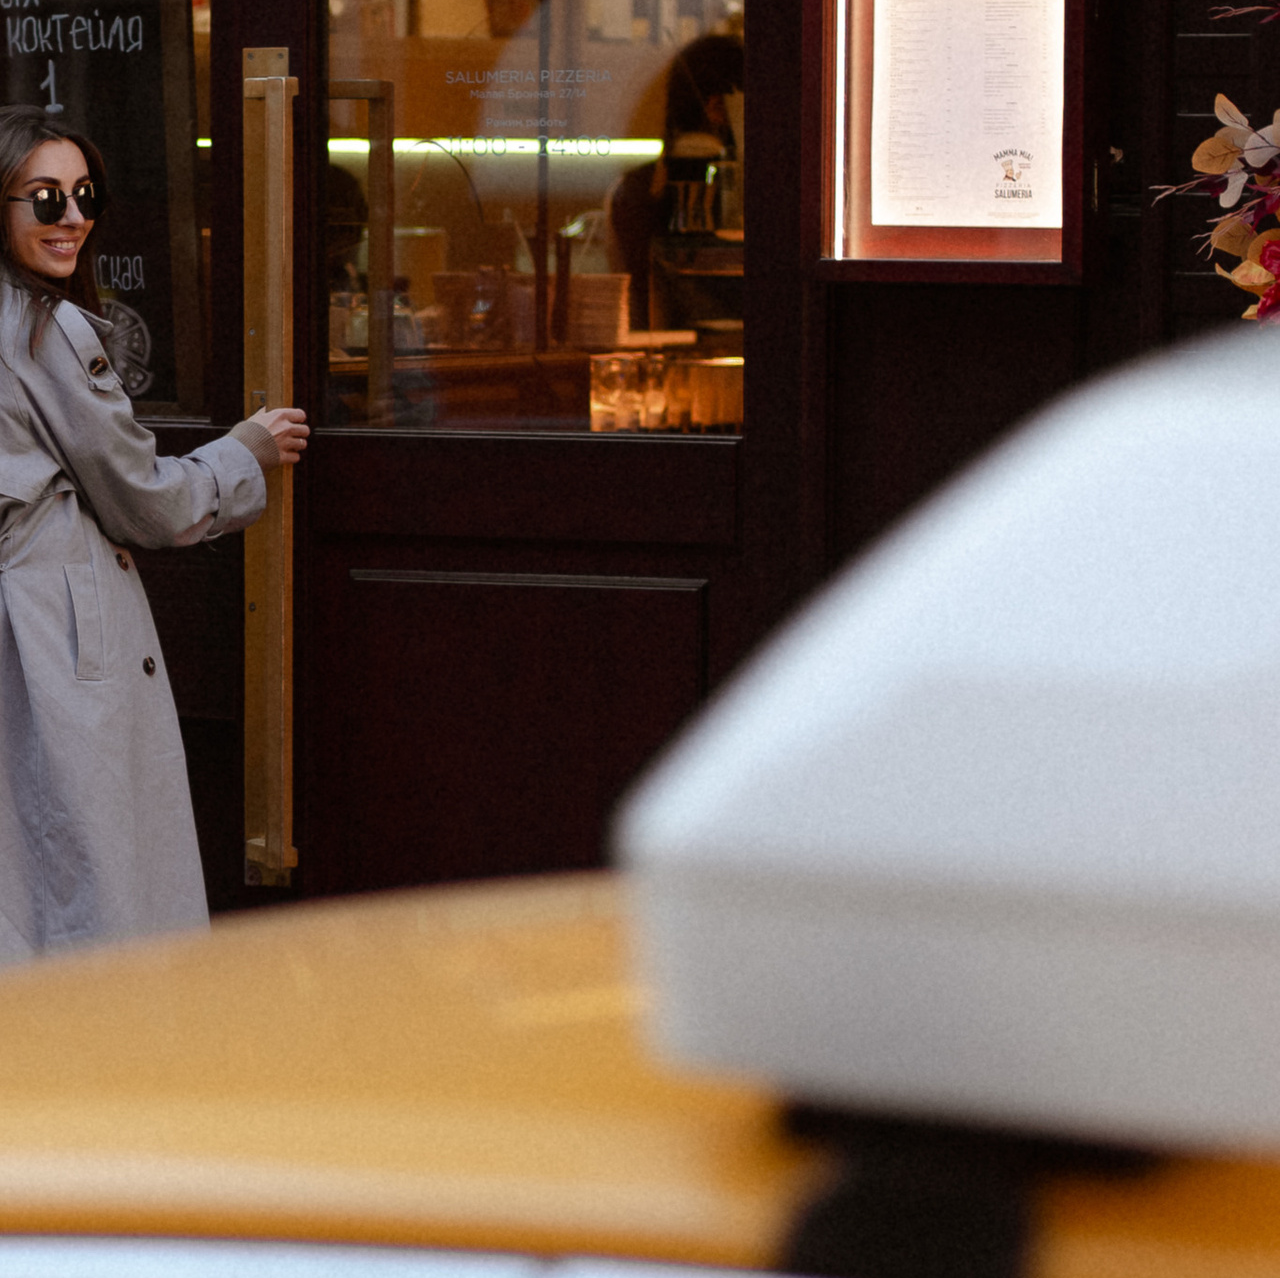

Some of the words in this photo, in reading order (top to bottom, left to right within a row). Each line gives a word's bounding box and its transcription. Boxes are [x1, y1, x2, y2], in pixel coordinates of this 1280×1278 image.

[445, 71, 536, 84] SALUMERIA
[540, 70, 613, 83] PIZZERIA
[39, 60, 65, 114] 1
[537, 135, 611, 157] 24:00
[994, 189, 1033, 199] SALUMERIA
